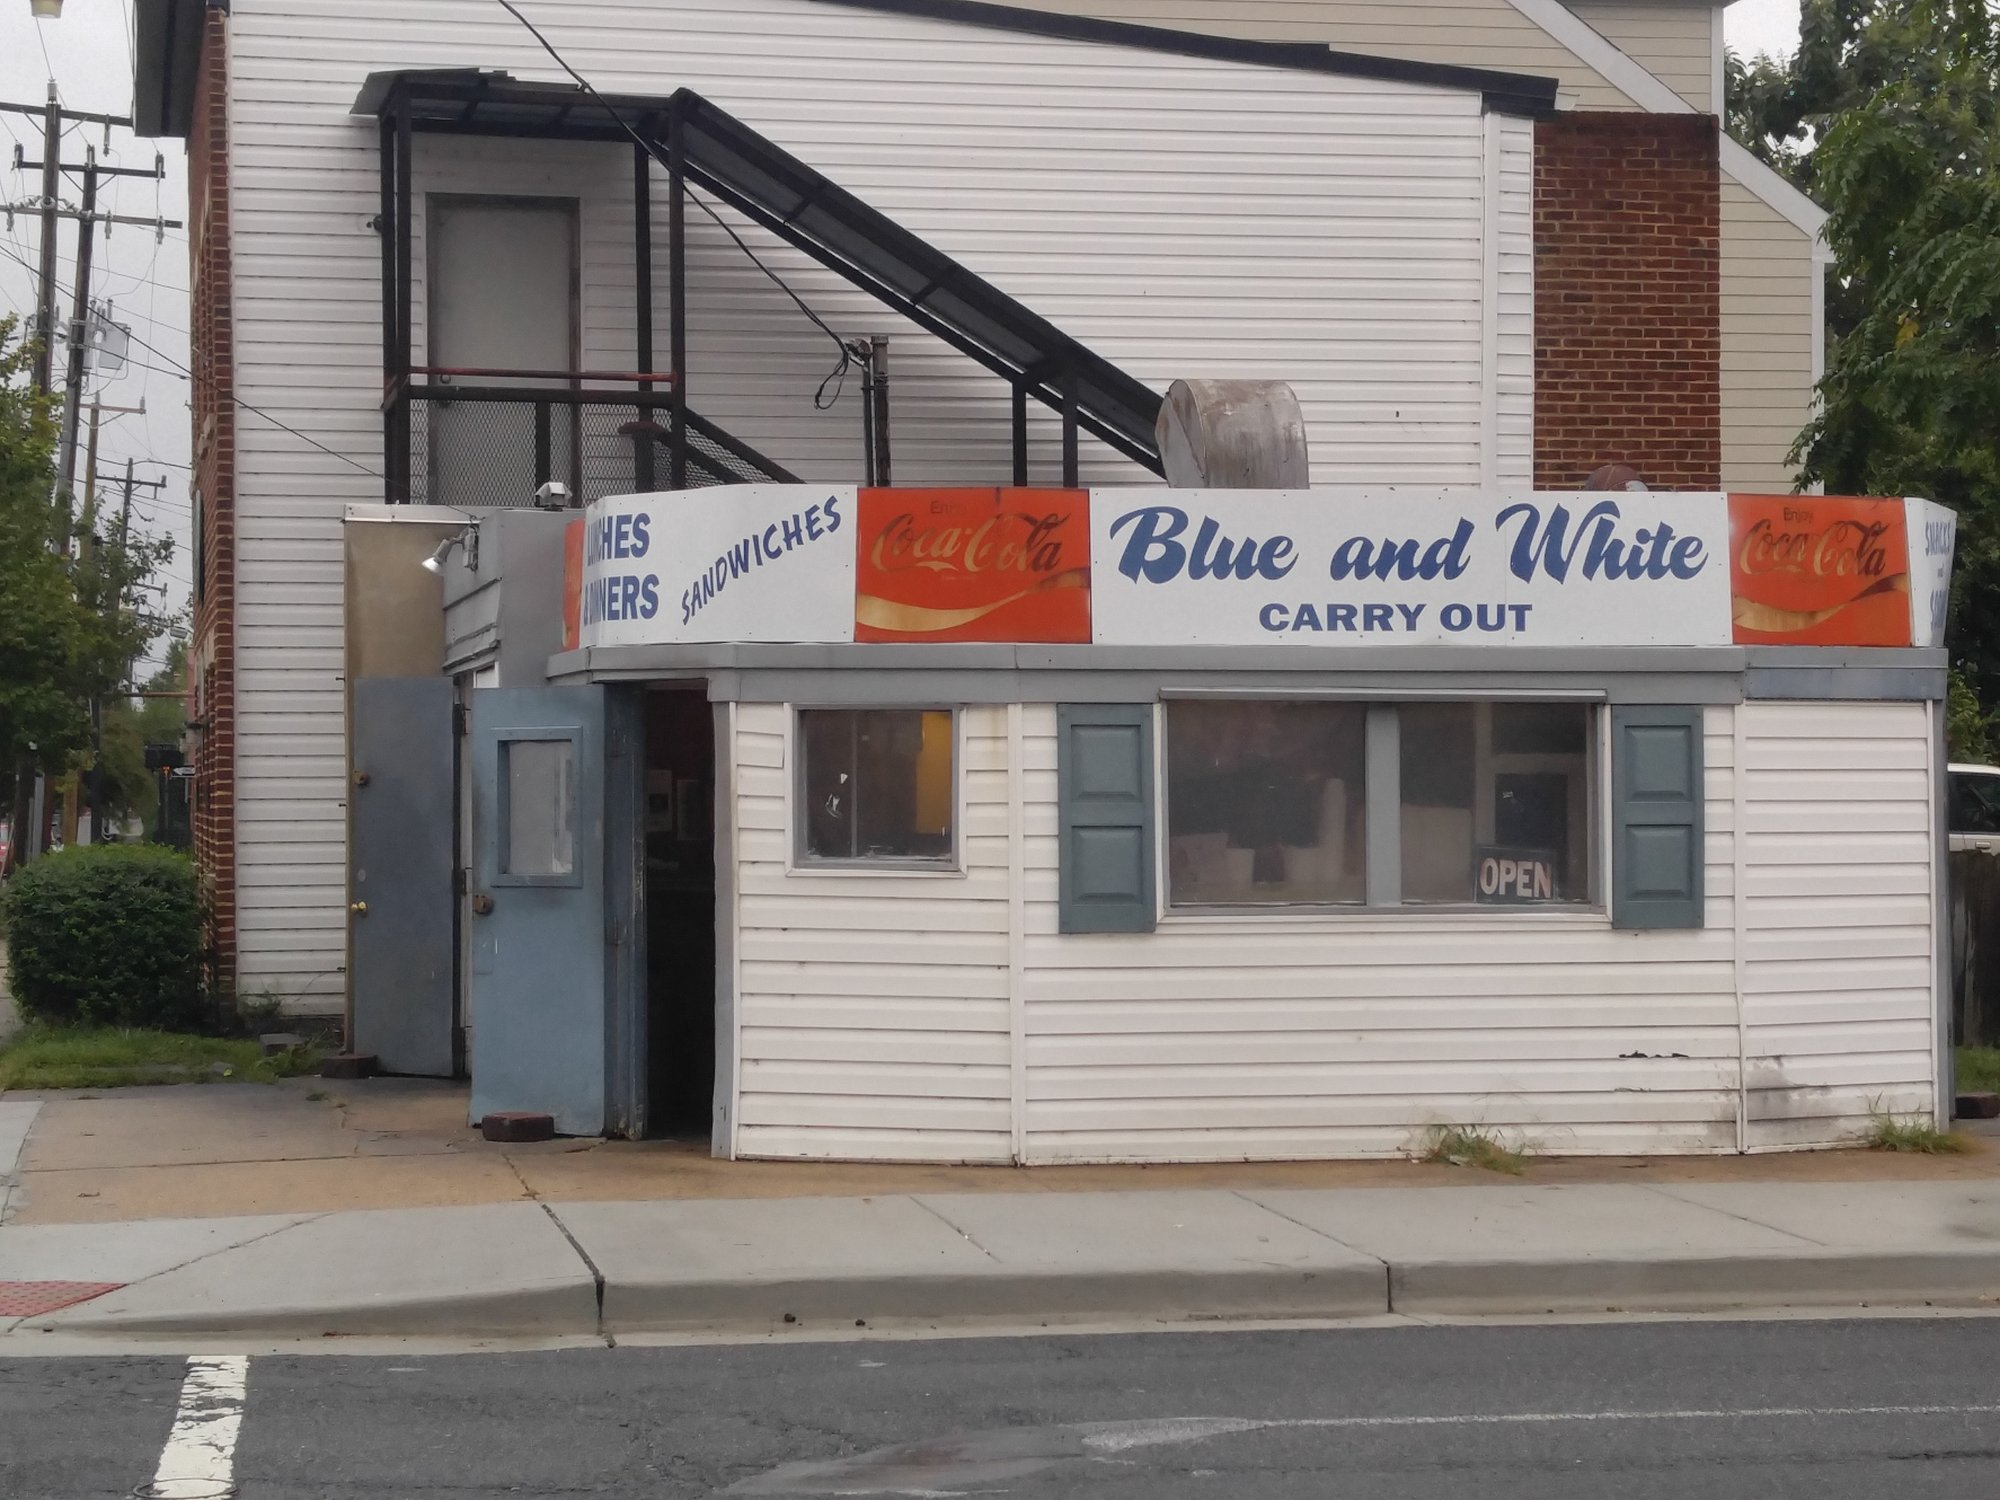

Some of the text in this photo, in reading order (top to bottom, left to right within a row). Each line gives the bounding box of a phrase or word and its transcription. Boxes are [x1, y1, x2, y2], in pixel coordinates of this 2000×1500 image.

[682, 495, 841, 626] SANDWICHES
[871, 513, 1071, 573] Coca-Cola
[1109, 501, 1709, 584] Blue and White
[1259, 603, 1533, 631] CARRY OUT
[1480, 858, 1552, 898] OPEN
